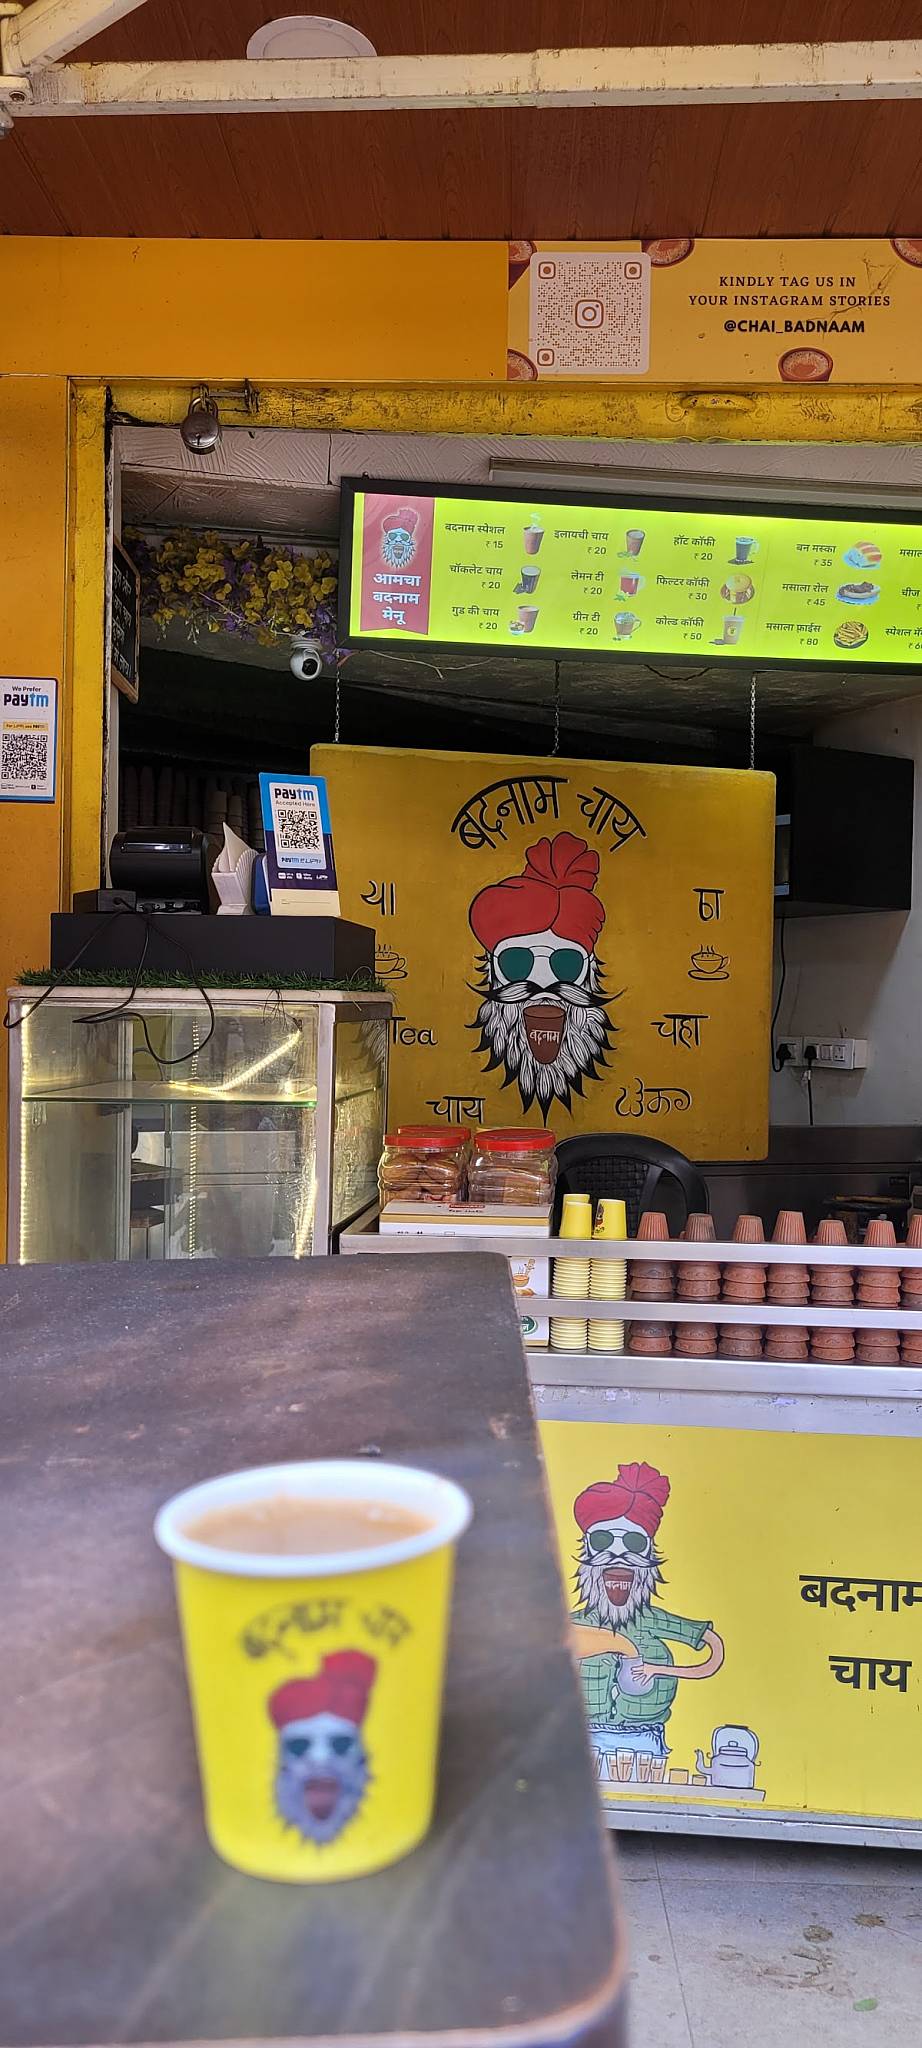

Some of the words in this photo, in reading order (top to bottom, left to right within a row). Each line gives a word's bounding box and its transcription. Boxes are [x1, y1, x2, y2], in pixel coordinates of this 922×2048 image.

[719, 276, 774, 287] KINDLY
[780, 276, 809, 287] TAG
[816, 277, 834, 287] US
[839, 277, 857, 287] IN
[689, 295, 728, 306] YOUR
[734, 295, 823, 306] INSTAGRAM
[829, 296, 891, 306] STORIES
[724, 319, 865, 333] @CHAI_BADNAAM
[591, 532, 609, 540] चाय
[493, 541, 504, 549] 15
[594, 547, 607, 555] 20
[700, 552, 713, 561] 20
[821, 559, 833, 567] 35
[485, 567, 503, 575] चाय
[571, 570, 592, 581] लेमन
[595, 570, 604, 582] टी
[373, 573, 422, 587] आमचा
[488, 581, 501, 589] 20
[590, 587, 603, 595] 20
[782, 583, 811, 592] मसाला
[372, 591, 421, 604] बदनाम
[695, 592, 708, 600] 30
[813, 598, 826, 606] 45
[382, 606, 407, 625] मेनू
[467, 605, 480, 615] की
[482, 608, 500, 617] चाय
[591, 611, 600, 622] टी
[486, 622, 498, 630] 20
[586, 627, 599, 635] 20
[766, 623, 795, 632] मसाला
[690, 632, 702, 641] 50
[451, 775, 568, 850] बदनाम
[577, 786, 647, 852] चाय
[391, 1016, 438, 1046] Tea
[651, 1014, 710, 1049] चहा
[529, 1029, 560, 1046] बदनाम
[425, 1096, 486, 1124] चाय
[829, 1655, 913, 1692] चाय
